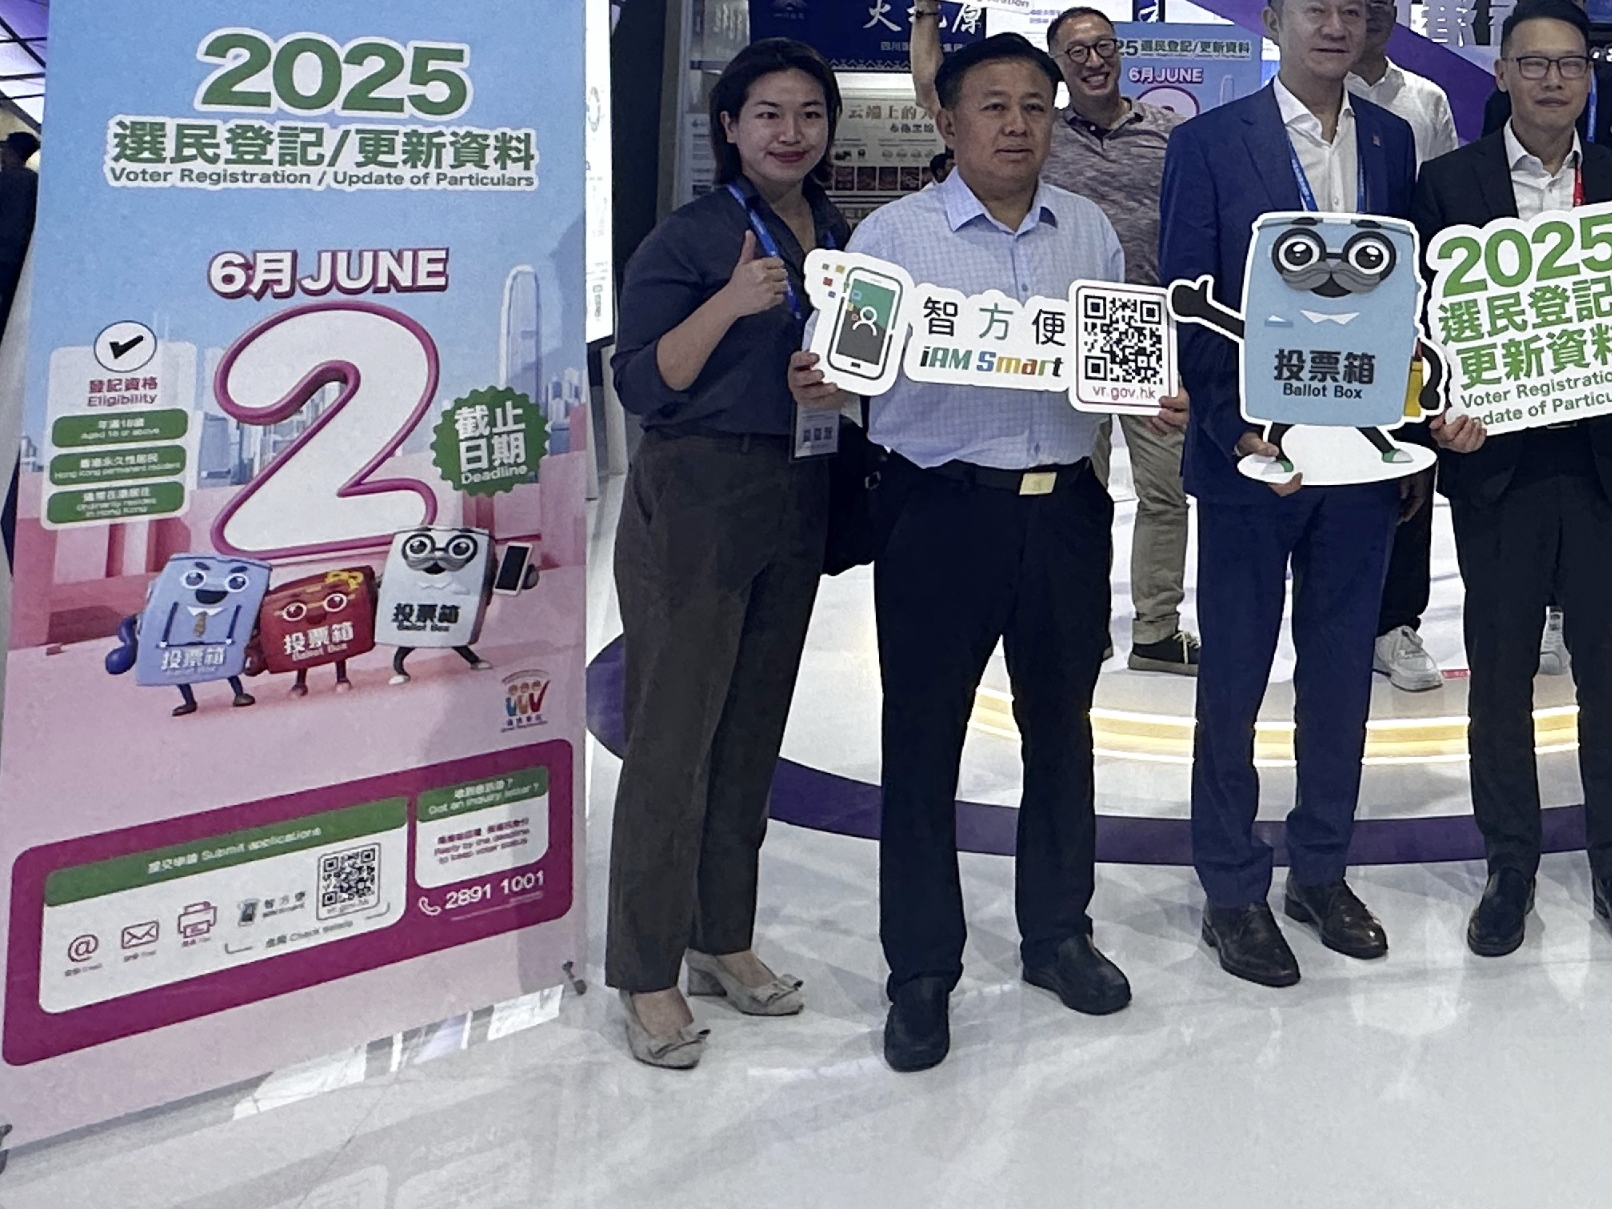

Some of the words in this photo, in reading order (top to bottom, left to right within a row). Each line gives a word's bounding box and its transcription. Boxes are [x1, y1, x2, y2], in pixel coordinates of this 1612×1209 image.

[198, 32, 469, 117] 2025
[1153, 68, 1203, 83] JUNE
[112, 120, 535, 171] 選民登記/更新資料
[111, 167, 173, 186] Voter
[179, 168, 311, 187] Registration
[333, 171, 405, 189] Update
[410, 171, 431, 186] of
[436, 171, 535, 188] Particulars
[299, 247, 449, 293] JUNE
[923, 297, 1067, 347] 智方便
[920, 345, 973, 371] iAM
[976, 351, 1063, 378] Smart
[1274, 348, 1375, 384] 投票箱
[88, 393, 157, 408] Eligibility
[1092, 386, 1156, 402] vr.gov.hk
[1283, 382, 1328, 399] Ballot
[1333, 384, 1363, 400] Box
[1461, 390, 1511, 409] Voter
[454, 404, 526, 439] 截止
[1471, 407, 1523, 427] pdate
[1528, 399, 1548, 417] of
[210, 301, 440, 559] 2
[459, 433, 527, 472] 日期
[460, 463, 527, 485] Deadline
[392, 603, 460, 623] 投票箱
[283, 622, 355, 654] 投票箱
[161, 647, 226, 669] 投票箱
[202, 843, 245, 861] Submit
[445, 883, 492, 909] 2891
[501, 870, 545, 895] 1001
